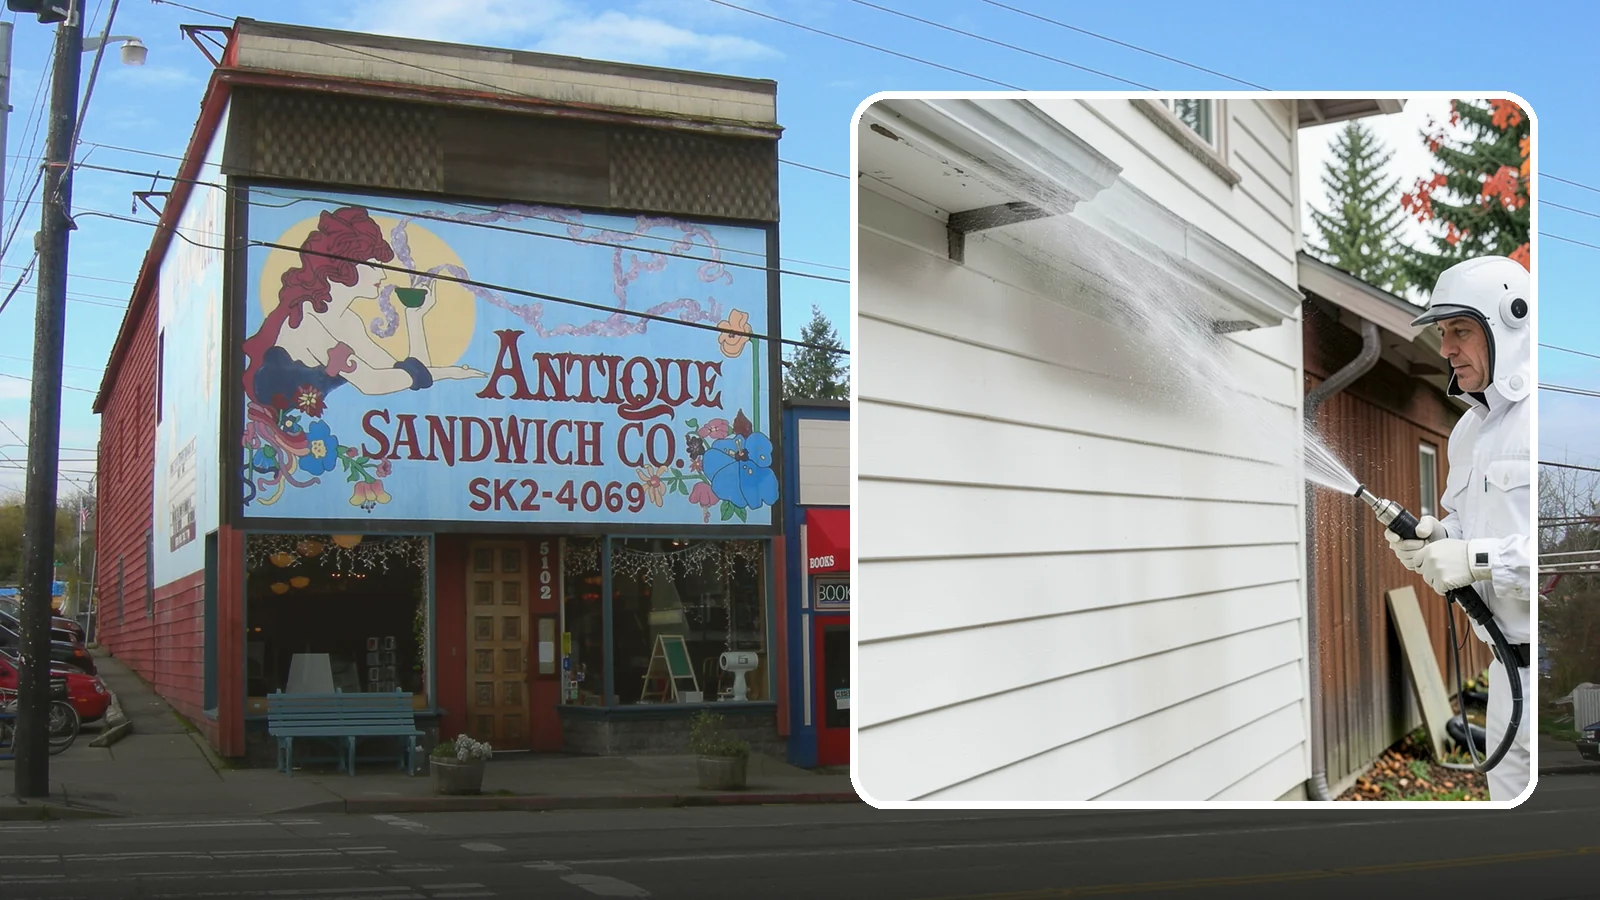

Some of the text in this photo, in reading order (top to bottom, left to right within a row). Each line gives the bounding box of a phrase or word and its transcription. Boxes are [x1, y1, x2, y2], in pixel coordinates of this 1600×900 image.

[476, 329, 723, 421] ANTIQUE
[361, 409, 685, 469] SANDWICH CO.
[468, 477, 645, 512] SK2-4069
[540, 542, 551, 599] 5102
[810, 555, 834, 569] BOOKS
